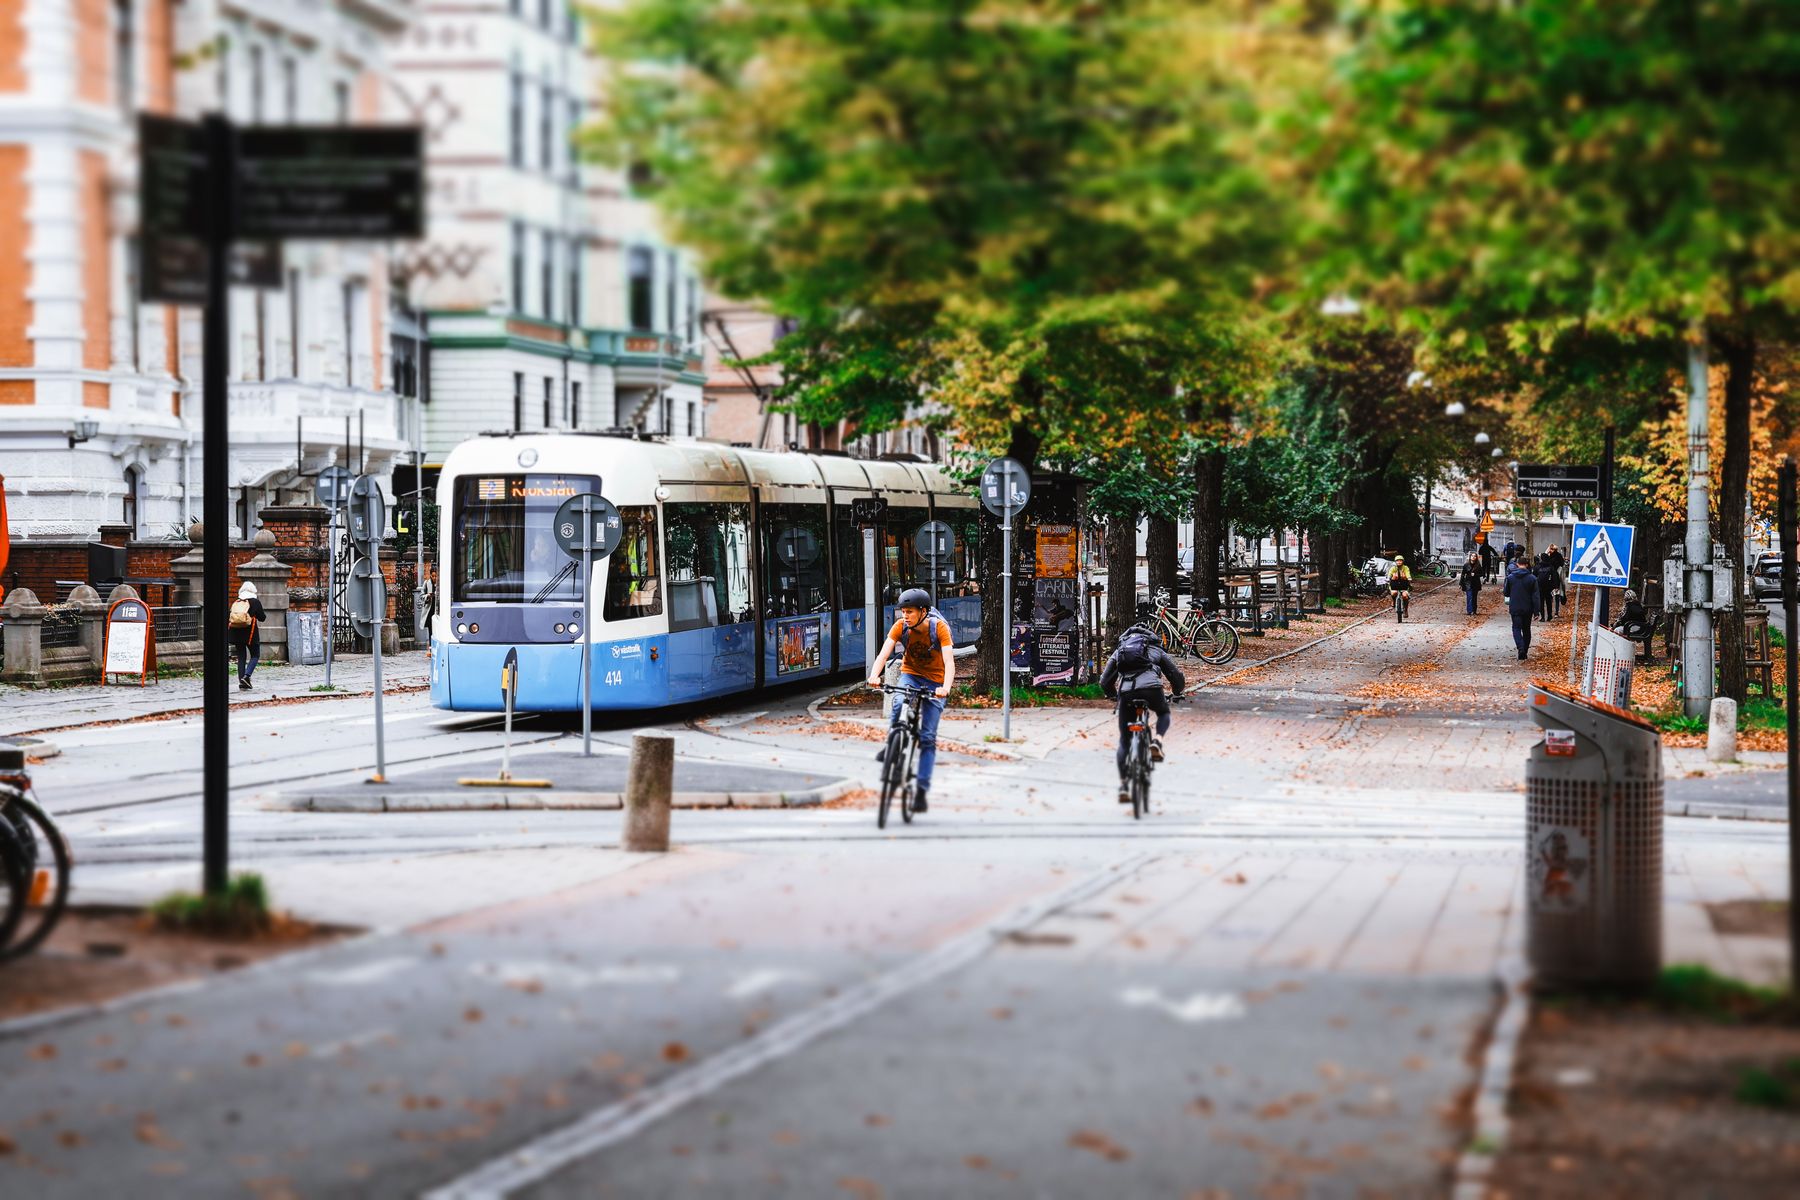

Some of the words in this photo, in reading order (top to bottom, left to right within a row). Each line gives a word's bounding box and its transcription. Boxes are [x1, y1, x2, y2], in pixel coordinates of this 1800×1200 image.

[1529, 489, 1574, 497] Wavrinskys
[1575, 489, 1594, 497] Plats
[1052, 525, 1072, 534] SOUNDS
[605, 670, 622, 686] 414
